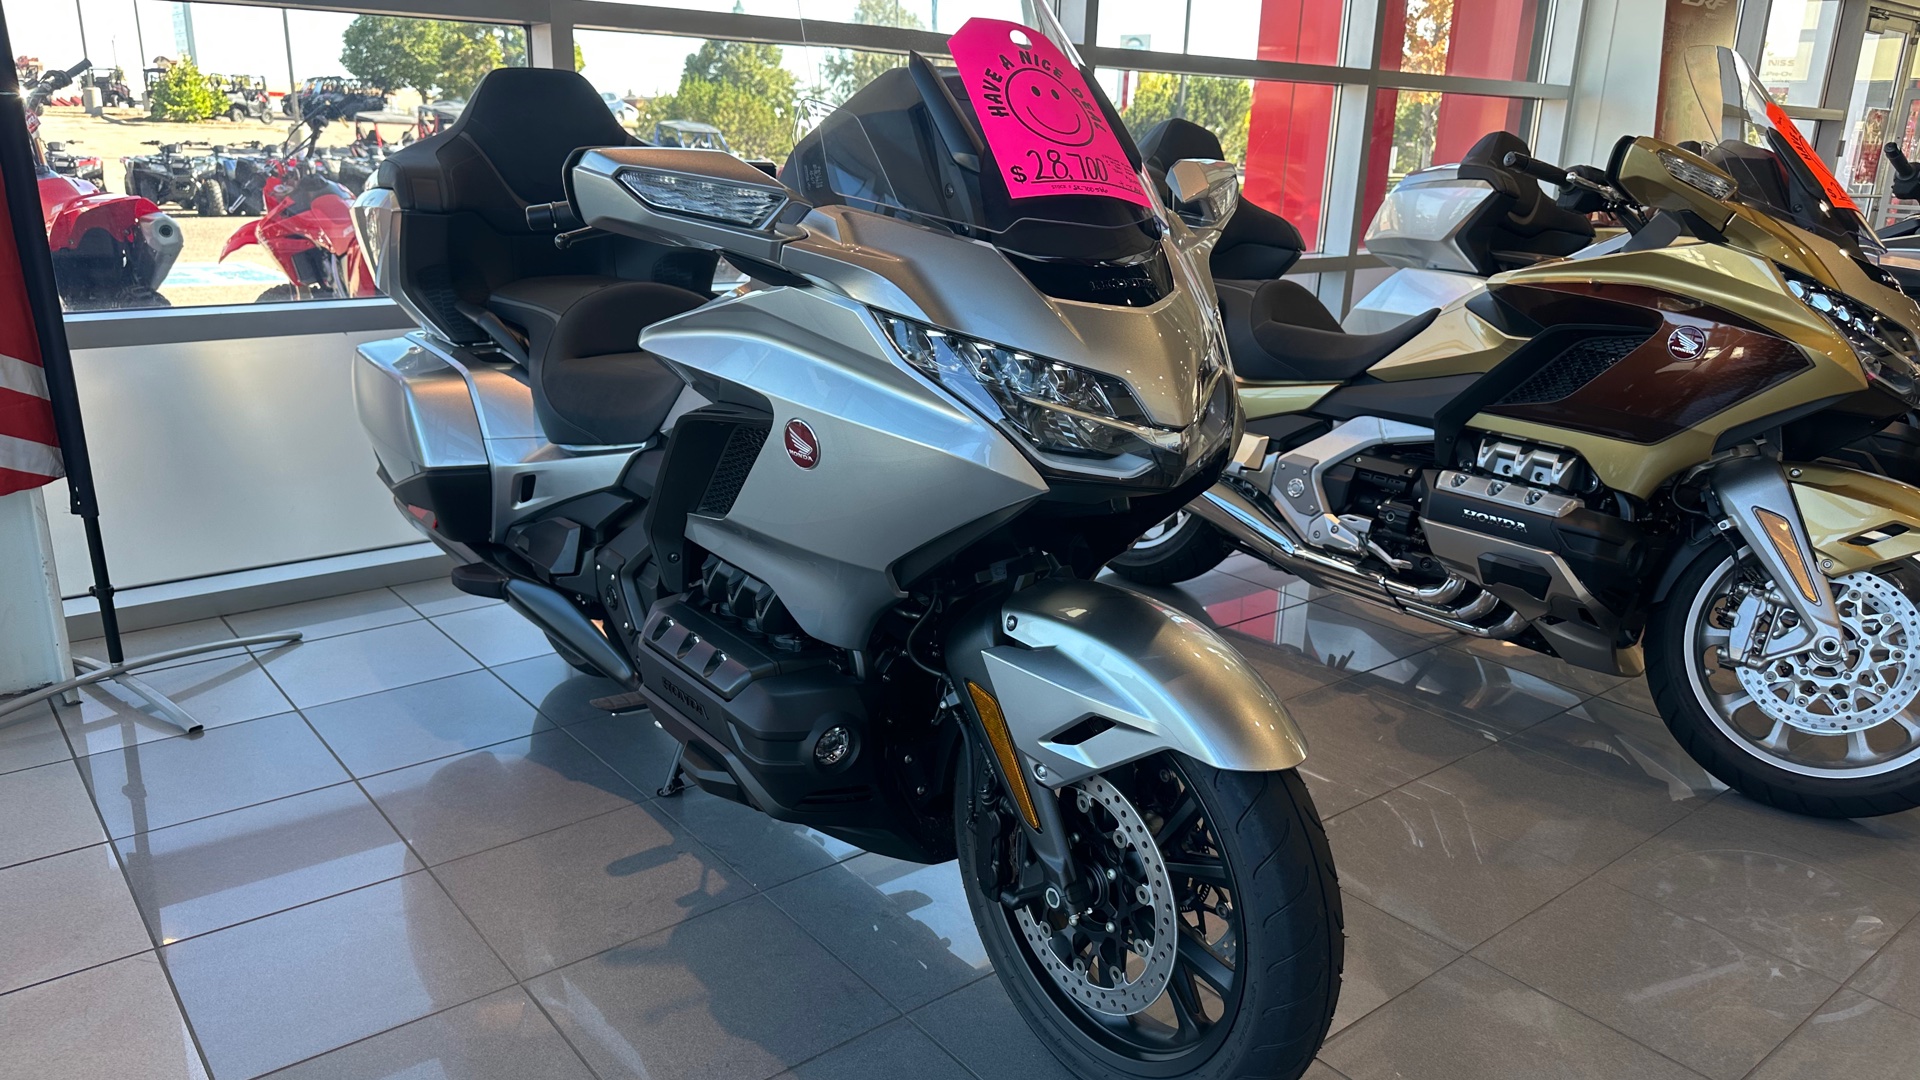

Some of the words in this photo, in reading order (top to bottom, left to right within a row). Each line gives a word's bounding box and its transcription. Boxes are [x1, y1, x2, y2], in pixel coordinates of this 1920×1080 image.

[983, 68, 1010, 117] HAVE
[999, 54, 1015, 70] A
[1018, 50, 1064, 80] NICE
[1071, 87, 1107, 133] DEAL
[1010, 165, 1027, 183] $
[1026, 149, 1109, 182] 28,700
[788, 448, 814, 462] HONDA
[1461, 508, 1528, 534] HONDA
[662, 677, 709, 720] HONDA
